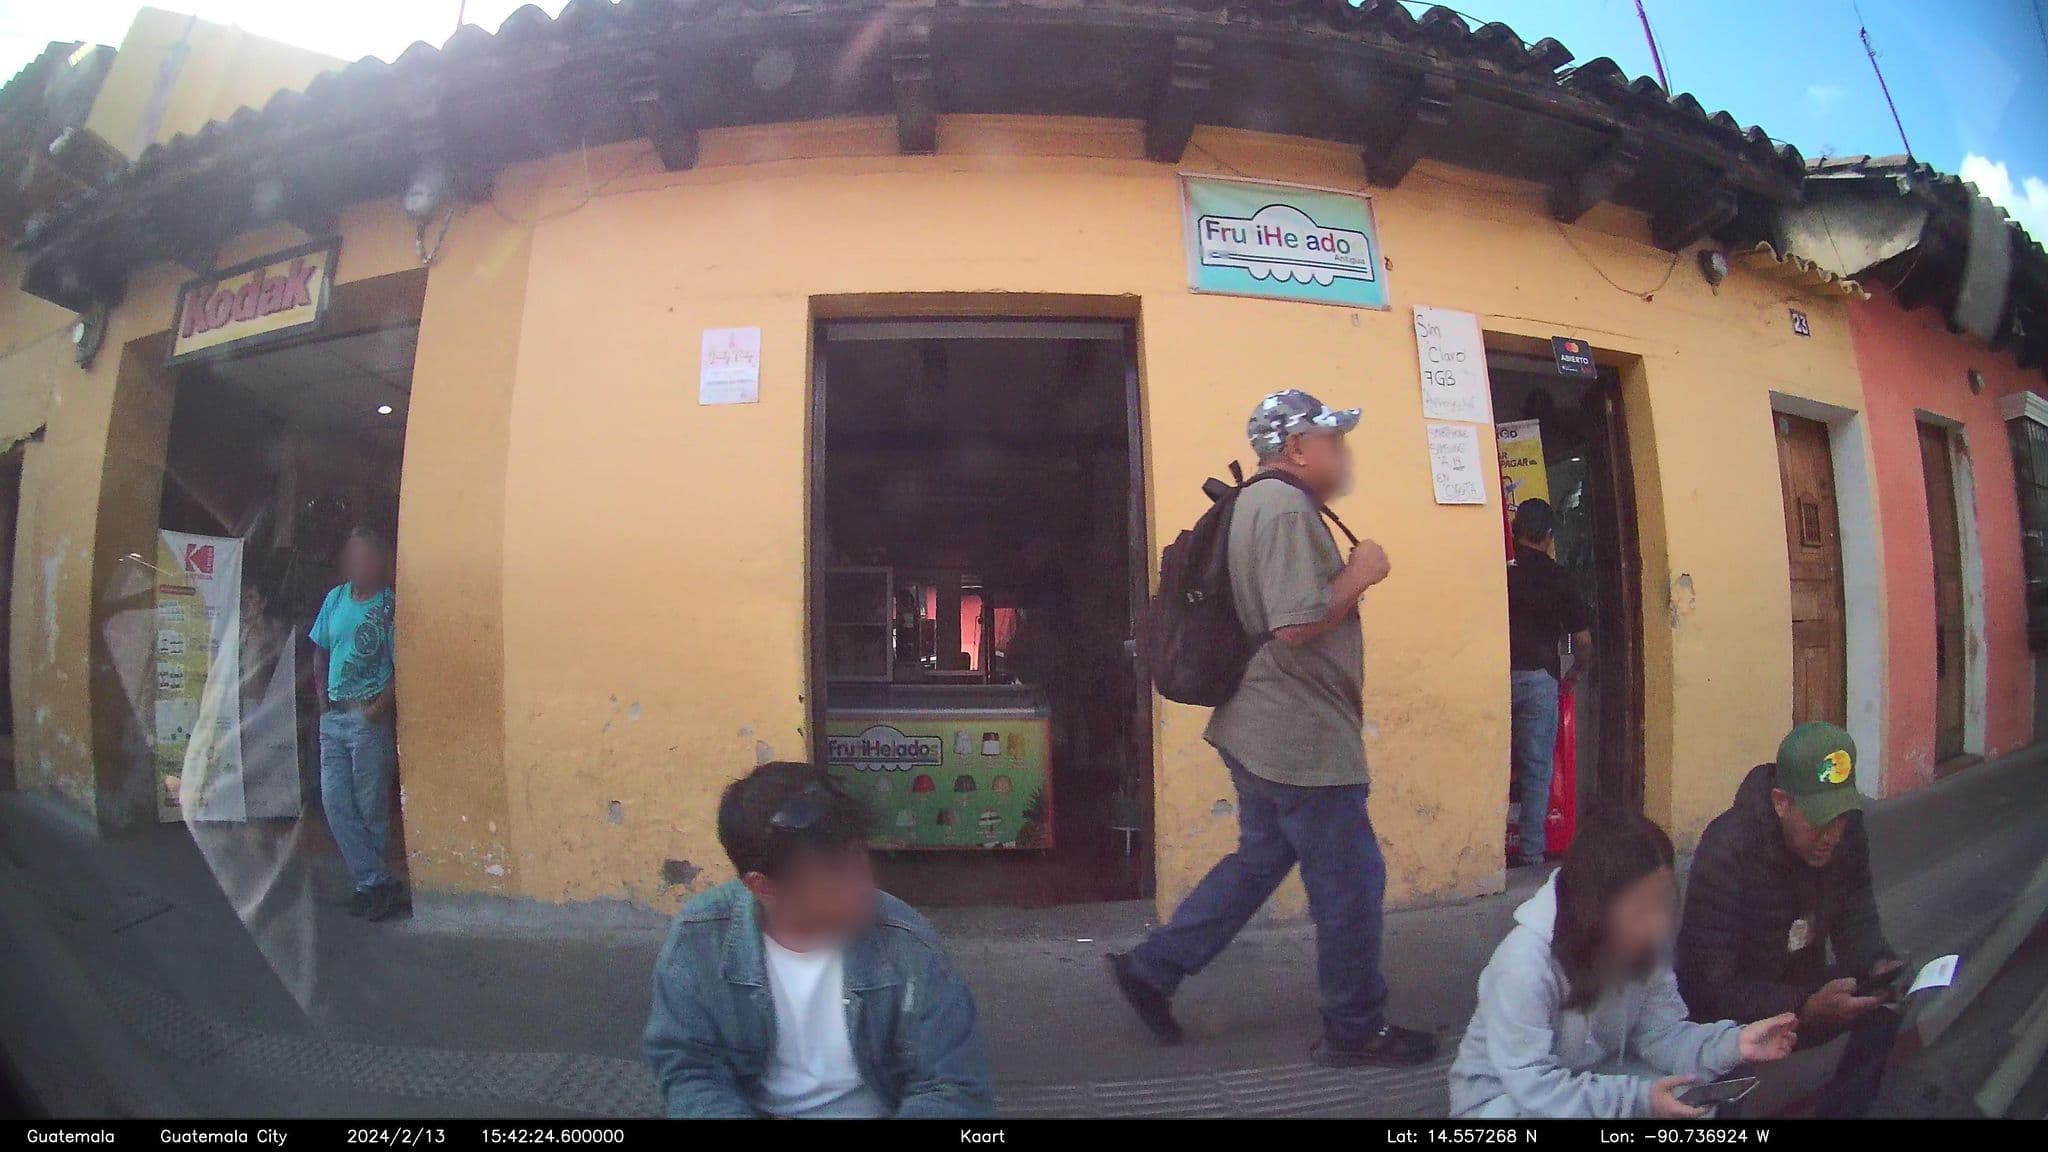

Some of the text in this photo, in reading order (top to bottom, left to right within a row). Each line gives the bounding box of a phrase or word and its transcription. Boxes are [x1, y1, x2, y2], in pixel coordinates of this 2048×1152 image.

[179, 258, 318, 338] Kodak
[1792, 313, 1808, 334] 23
[1429, 346, 1466, 363] Claro
[1561, 355, 1589, 364] ABIERTO
[1425, 369, 1456, 386] 7GB
